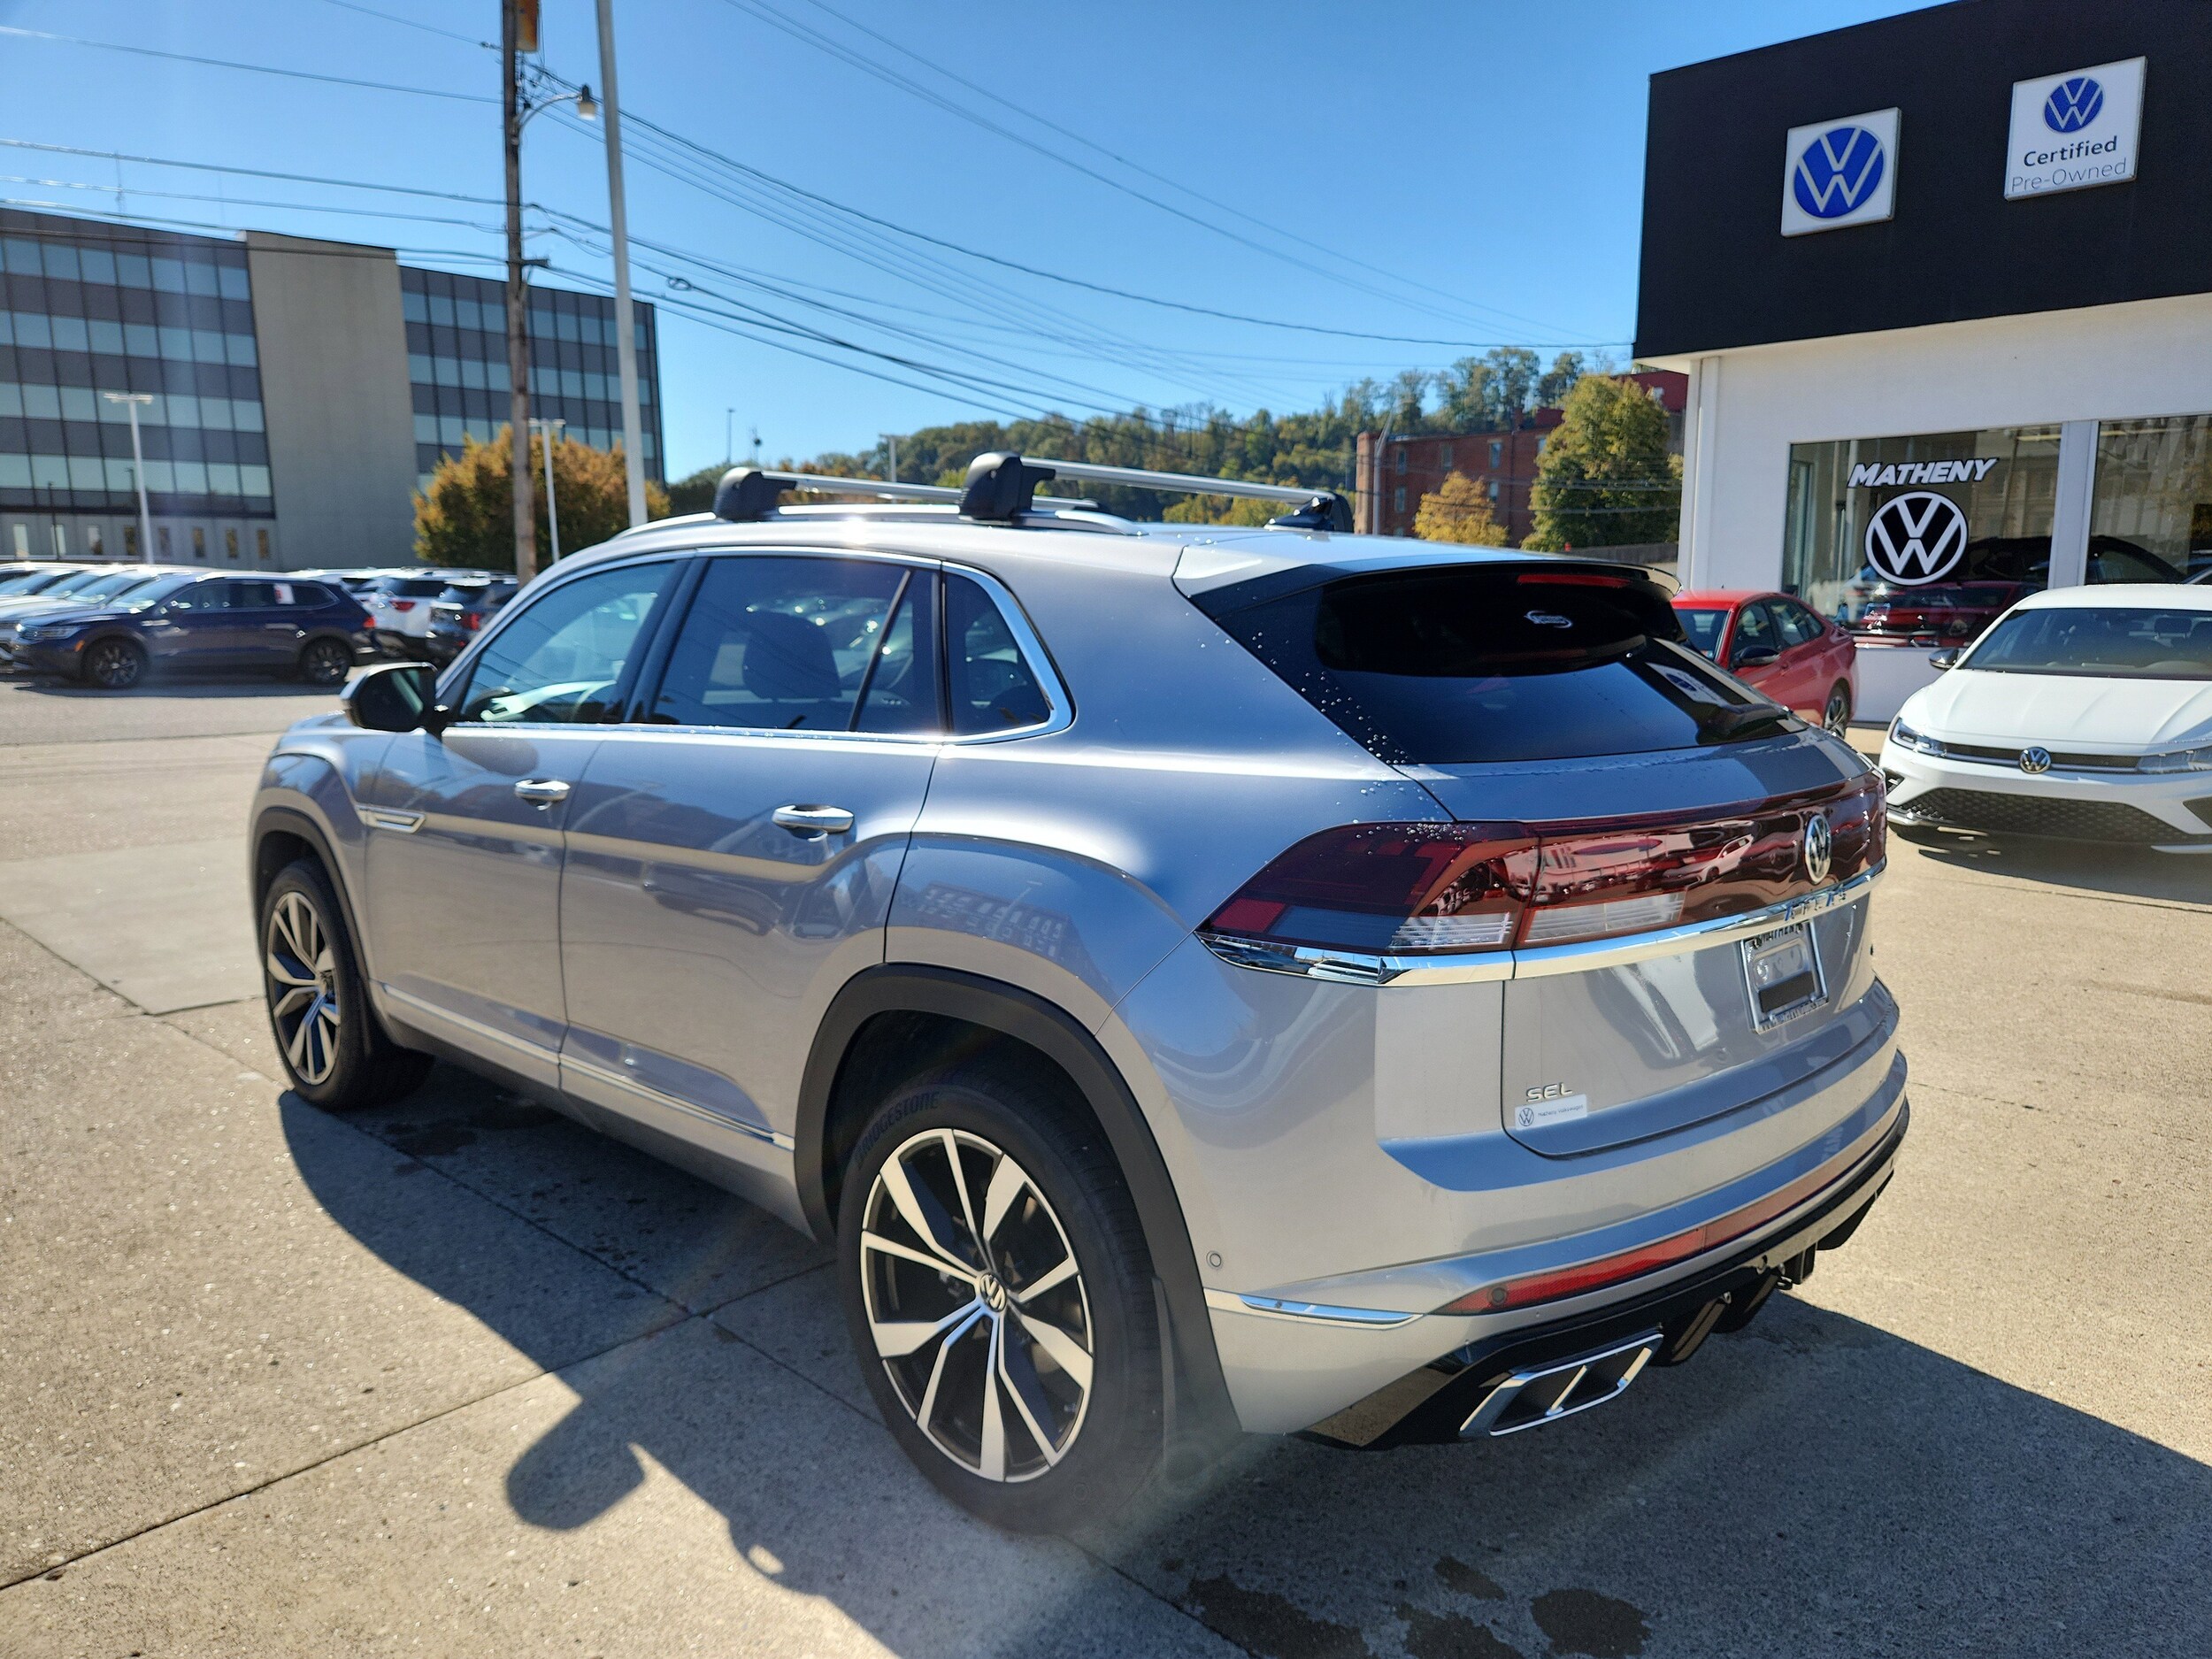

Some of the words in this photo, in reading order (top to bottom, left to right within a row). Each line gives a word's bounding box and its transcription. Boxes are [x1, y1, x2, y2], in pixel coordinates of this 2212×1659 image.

[2042, 77, 2104, 133] VW
[2023, 135, 2118, 167] Certified
[1793, 125, 1885, 219] VW
[2010, 157, 2127, 193] Pre-Owned
[1847, 457, 2000, 488] MATHENY
[1864, 490, 1969, 587] VW
[1526, 1081, 1573, 1102] SEL
